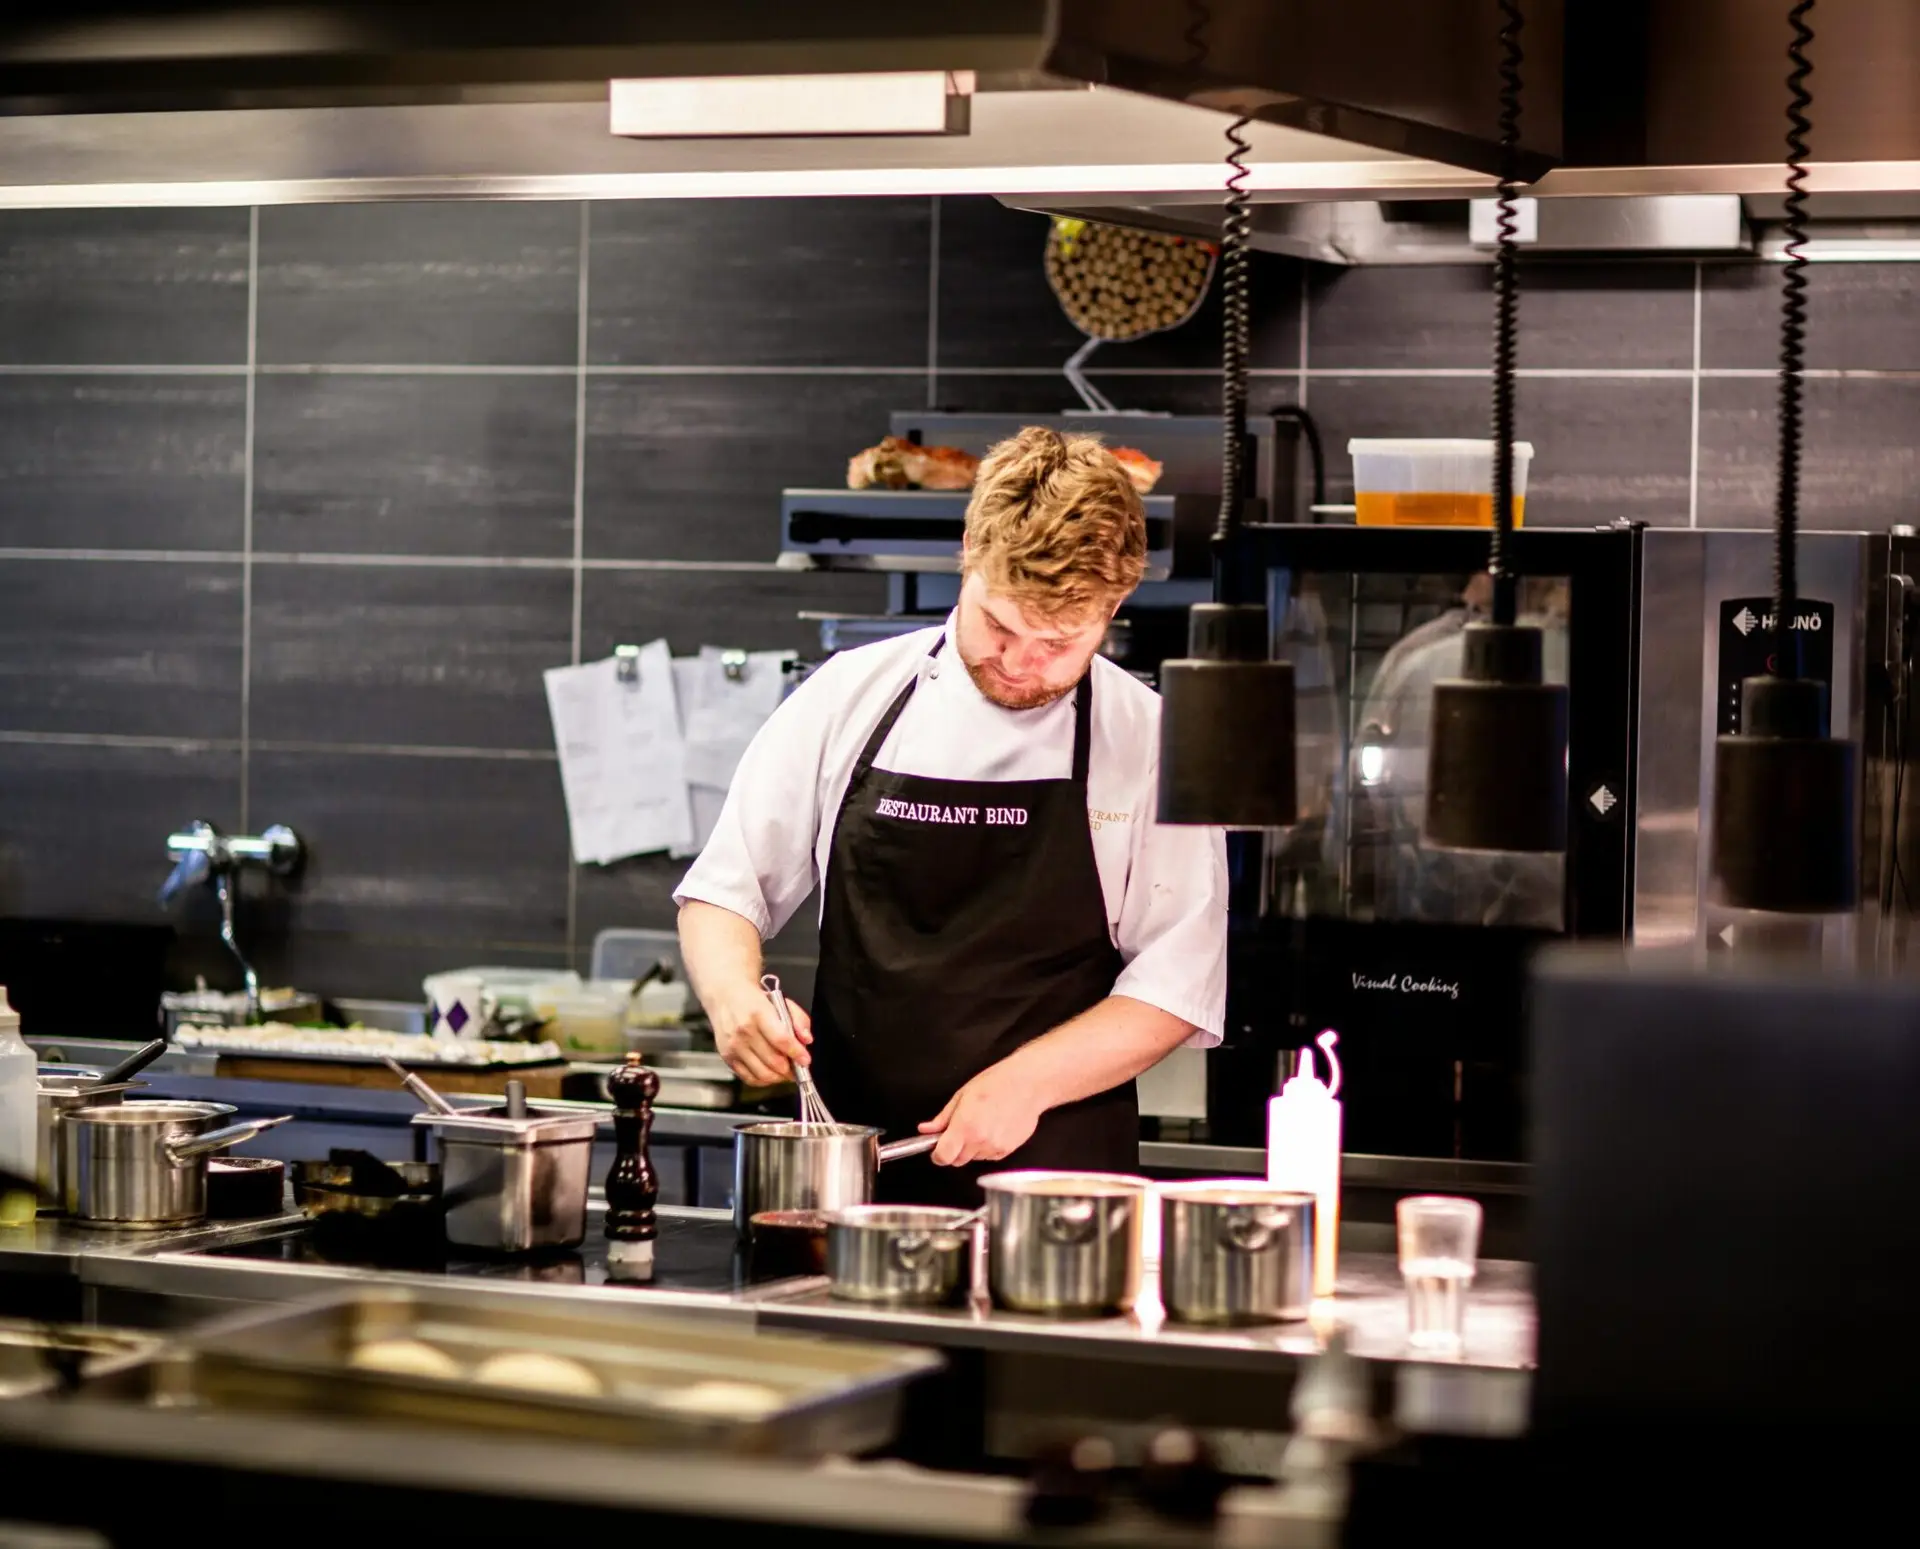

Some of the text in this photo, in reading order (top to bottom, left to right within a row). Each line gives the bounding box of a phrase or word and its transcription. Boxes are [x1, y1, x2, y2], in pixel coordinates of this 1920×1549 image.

[1761, 612, 1822, 631] HUNÖ
[876, 798, 1028, 825] RESTAURANT BIND
[1352, 972, 1459, 1000] Visual Cooking
